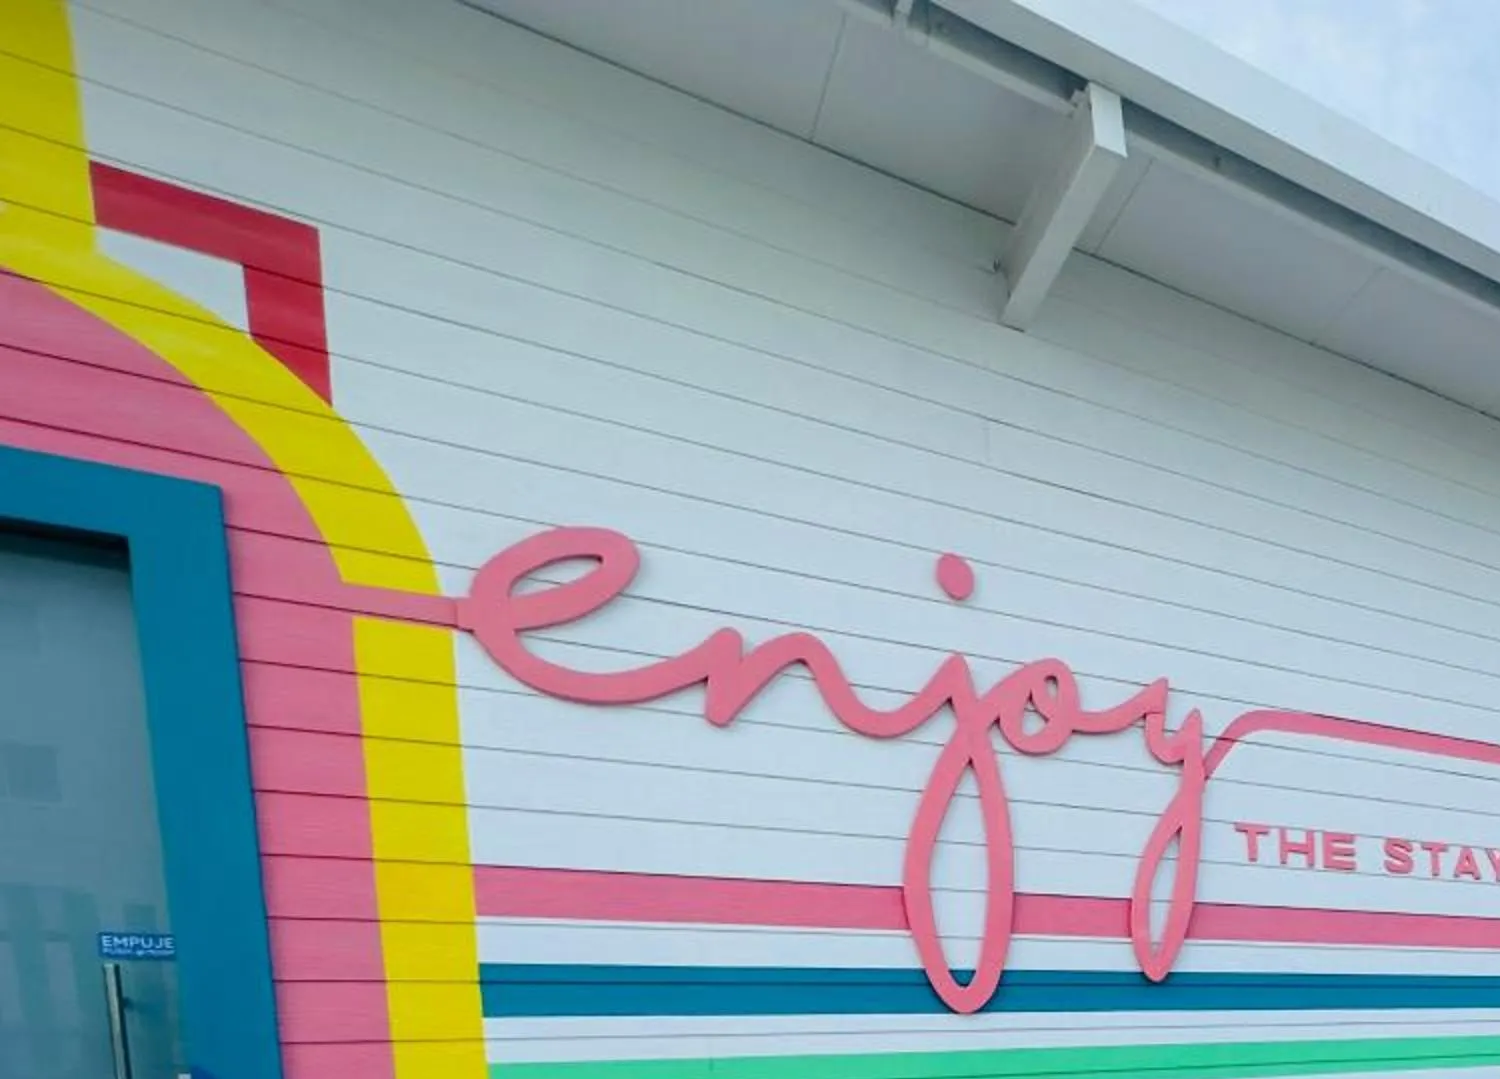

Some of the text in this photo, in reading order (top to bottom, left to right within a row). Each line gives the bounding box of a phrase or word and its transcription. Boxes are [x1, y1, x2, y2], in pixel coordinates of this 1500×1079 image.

[466, 526, 1207, 1014] enjoy
[1234, 821, 1357, 871] THE
[101, 935, 175, 949] EMPUJE
